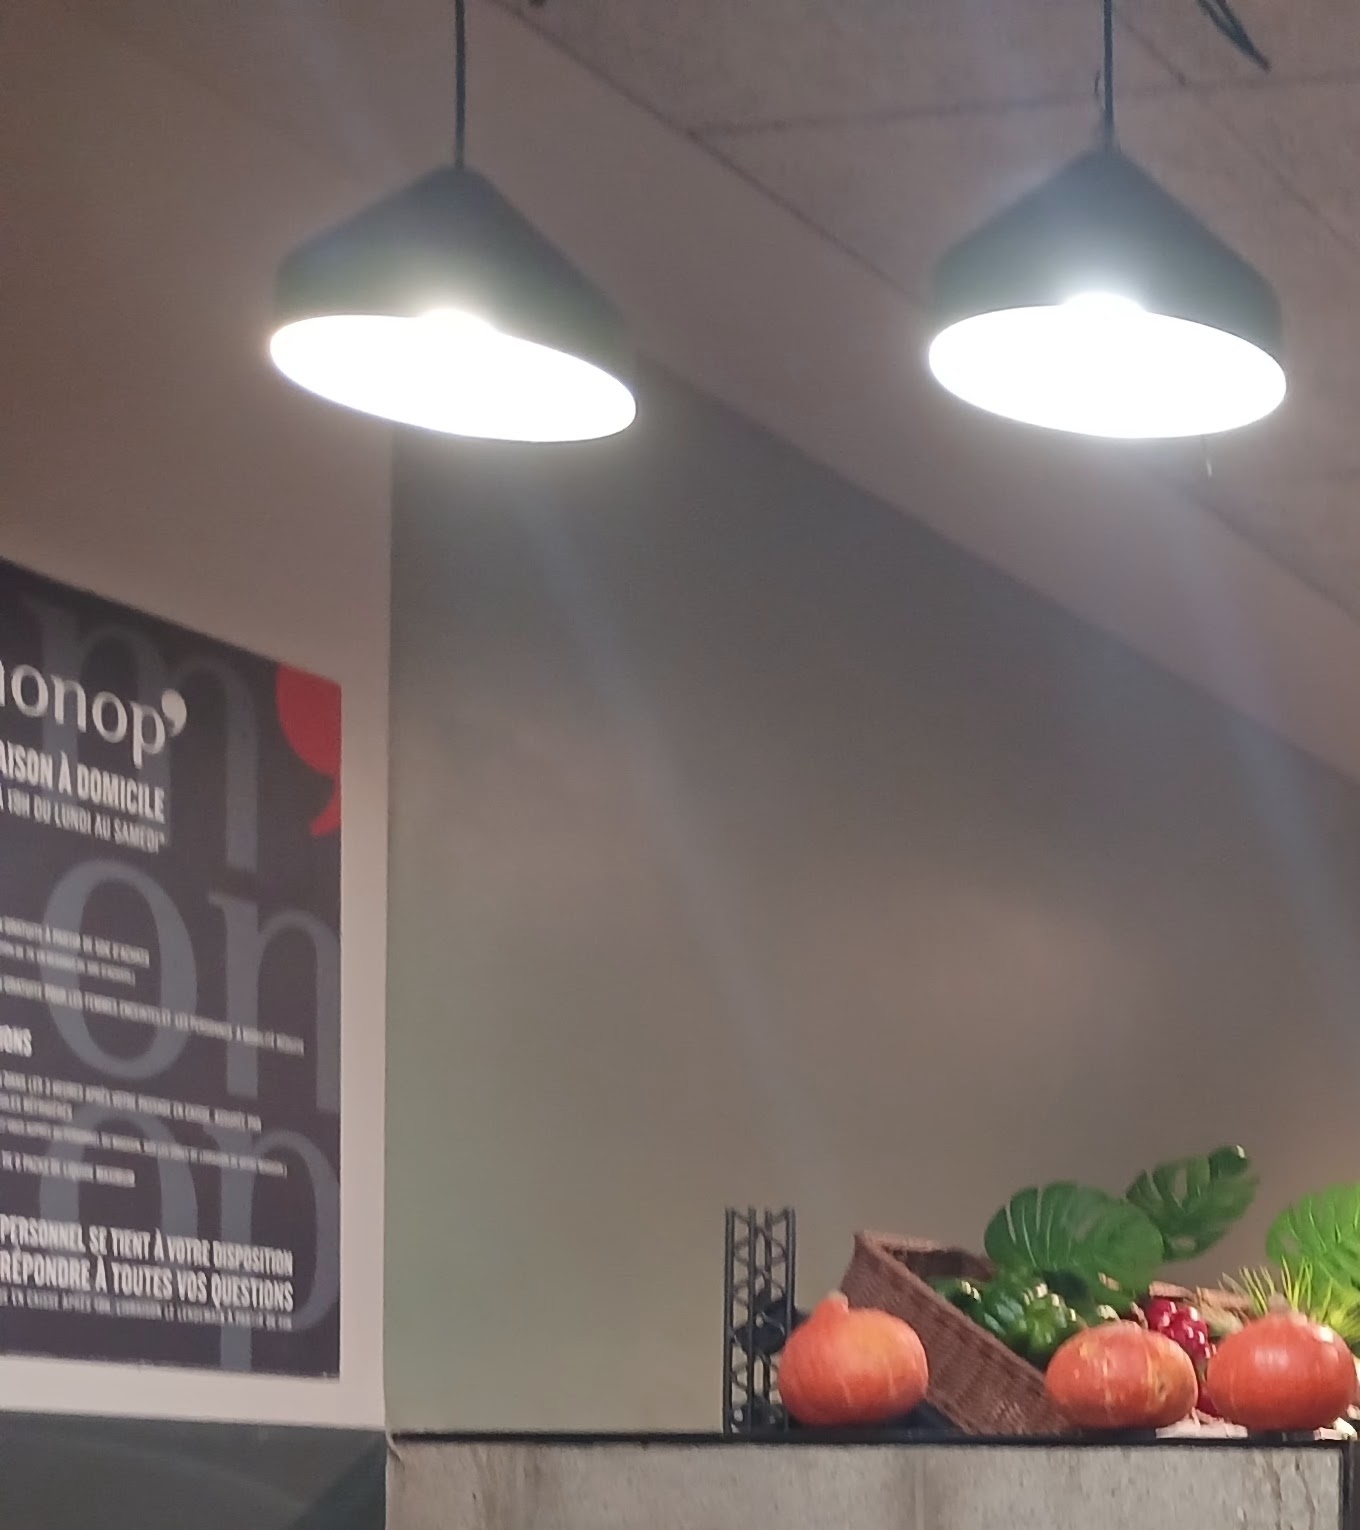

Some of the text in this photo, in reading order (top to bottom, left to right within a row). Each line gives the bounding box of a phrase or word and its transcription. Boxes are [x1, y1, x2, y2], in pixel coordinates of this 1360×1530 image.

[0, 659, 187, 769] onop'
[54, 801, 91, 835] LUNDI
[94, 813, 111, 841] AU
[77, 763, 165, 824] DOMICILE
[88, 1224, 108, 1256] SE
[110, 1227, 150, 1260] TIENT
[166, 1235, 211, 1267] VOTRE
[212, 1241, 293, 1277] DISPOSITION
[95, 1255, 108, 1293] À
[112, 1262, 173, 1300] TOUTES
[176, 1270, 208, 1304] VOS
[211, 1272, 294, 1312] QUESTIONS
